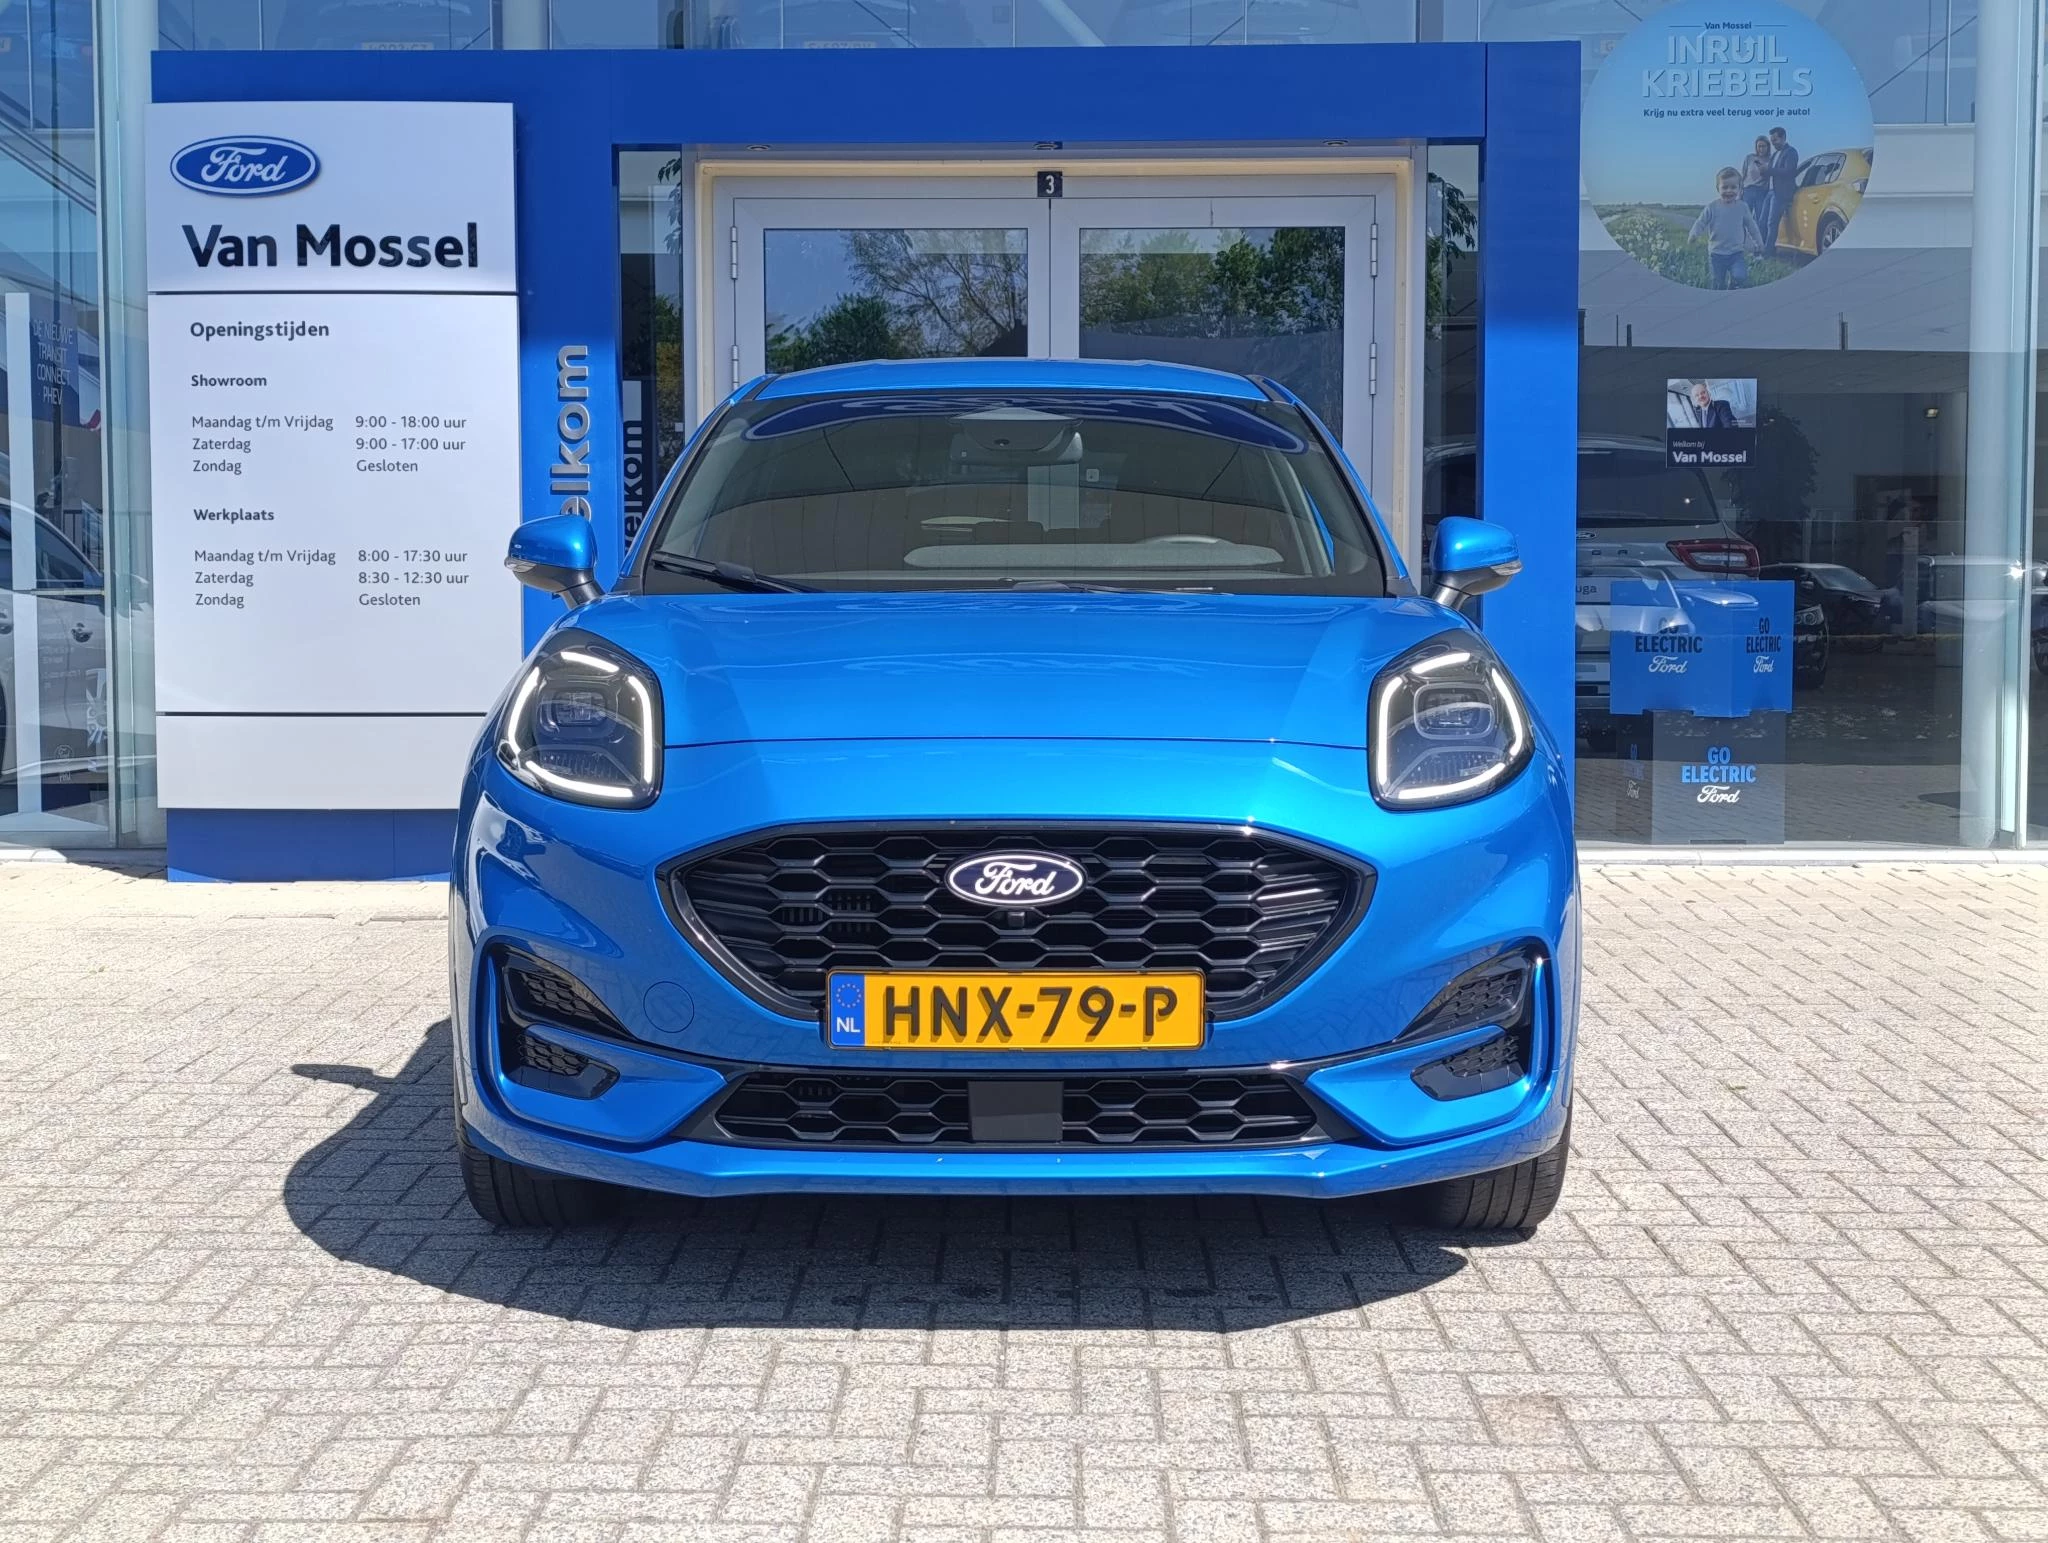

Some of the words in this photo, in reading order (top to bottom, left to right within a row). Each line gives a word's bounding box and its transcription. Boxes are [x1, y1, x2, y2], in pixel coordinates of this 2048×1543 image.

[1704, 21, 1721, 30] Van
[1722, 20, 1752, 30] Mossel
[1668, 34, 1789, 64] INRUIL
[1642, 67, 1813, 97] KRIEBELS
[1643, 108, 1665, 119] Krijg
[1667, 109, 1678, 117] nu
[1680, 108, 1704, 117] extra
[1706, 107, 1725, 117] veel
[1727, 108, 1752, 119] terug
[1754, 108, 1774, 117] voor
[1776, 107, 1786, 118] je
[1787, 107, 1811, 117] auto!
[200, 146, 288, 183] Ford
[1045, 174, 1055, 194] 3
[181, 224, 278, 268] Van
[296, 222, 479, 268] Mossel
[190, 321, 330, 342] Openingstijden
[190, 374, 268, 388] Showroom
[192, 415, 253, 432] Maandag
[255, 416, 281, 428] t/m
[284, 415, 334, 432] Vrijdag
[355, 416, 387, 428] 9:00
[401, 415, 440, 428] 18:00
[444, 419, 467, 428] uur
[551, 345, 592, 523] elkom
[192, 437, 252, 454] Zaterdag
[356, 438, 388, 450] 9:00
[401, 437, 439, 450] 17:00
[443, 441, 466, 450] uur
[1672, 450, 1698, 463] Van
[1701, 450, 1747, 463] Mossel
[193, 459, 243, 475] Zondag
[356, 459, 419, 472] Gesloten
[623, 420, 643, 550] elkom
[194, 507, 275, 525] Werkplaats
[194, 549, 255, 566] Maandag
[257, 550, 283, 562] t/m
[287, 549, 337, 566] Vrijdag
[358, 550, 390, 562] 8:00
[404, 550, 441, 562] 17:30
[444, 552, 468, 562] uur
[195, 571, 255, 588] Zaterdag
[358, 571, 390, 584] 8:30
[404, 571, 443, 584] 12:30
[446, 574, 470, 584] uur
[1576, 585, 1598, 596] uga
[195, 593, 245, 609] Zondag
[358, 593, 421, 606] Gesloten
[1759, 617, 1770, 635] GO
[1635, 636, 1703, 653] ELECTRIC
[1746, 636, 1782, 653] ELECTRIC
[1648, 655, 1688, 674] Ford
[1753, 655, 1774, 674] Ford
[1707, 747, 1731, 764] GO
[1681, 765, 1756, 783] ELECTRIC
[1696, 785, 1740, 803] Ford
[973, 860, 1058, 897] Ford
[884, 985, 1179, 1040] HNX-79-P
[836, 1017, 861, 1033] NL
